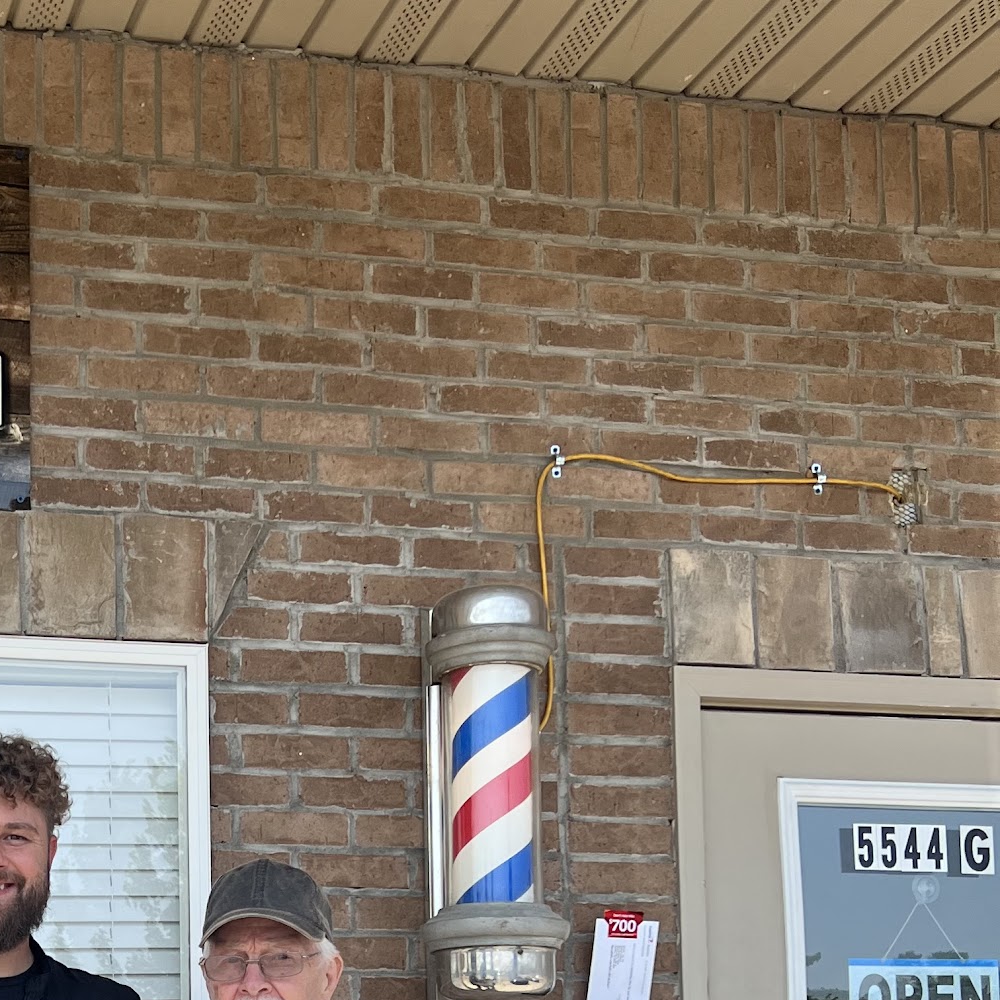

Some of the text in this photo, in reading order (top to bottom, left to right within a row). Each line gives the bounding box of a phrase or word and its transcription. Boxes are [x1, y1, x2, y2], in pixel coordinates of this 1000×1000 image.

[857, 826, 991, 872] 5544 G
[608, 918, 637, 933] $700
